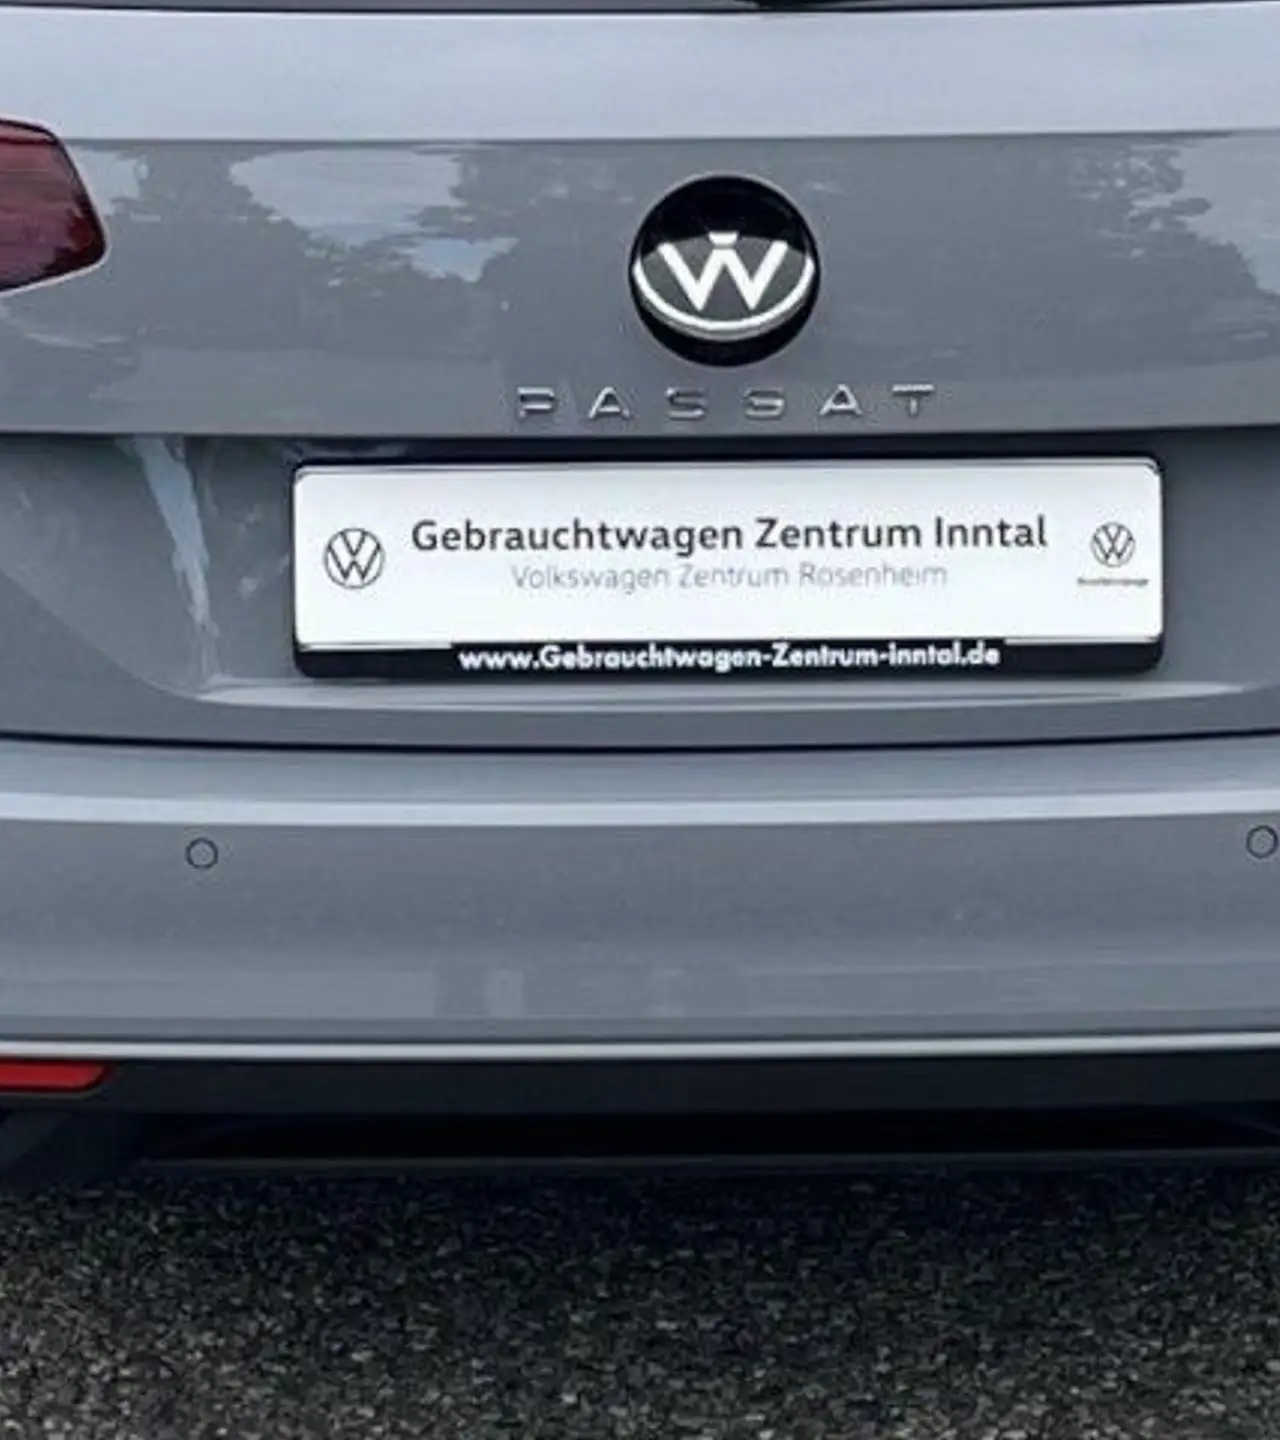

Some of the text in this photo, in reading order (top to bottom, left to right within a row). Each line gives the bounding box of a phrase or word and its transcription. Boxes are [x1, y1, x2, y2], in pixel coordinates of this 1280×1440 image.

[517, 383, 935, 420] PASSAT
[411, 514, 1048, 559] Gebrauchtwagen Zentrum Inntal
[512, 561, 949, 595] Volkswagen Zentrum Rosenheim
[459, 642, 1002, 674] www.Gebrauchtwagen-Zentrum-inntal.de
